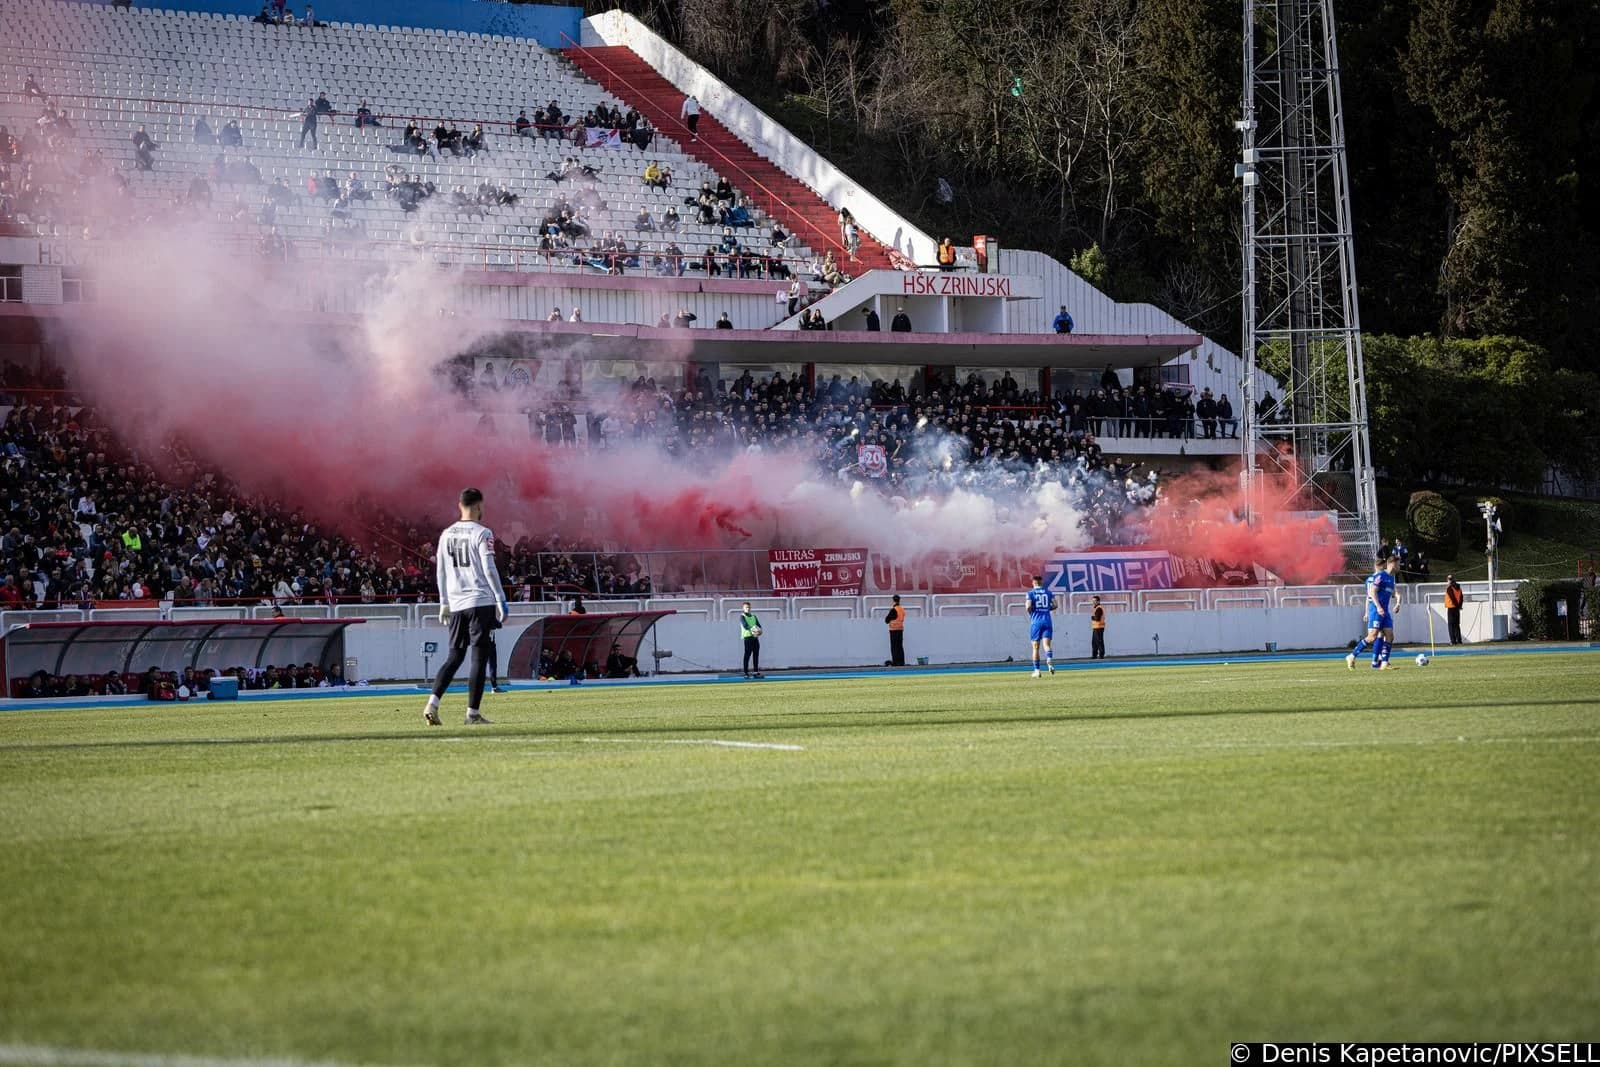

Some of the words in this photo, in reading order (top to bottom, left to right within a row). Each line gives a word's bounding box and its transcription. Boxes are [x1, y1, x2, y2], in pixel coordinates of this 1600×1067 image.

[903, 272, 936, 294] HŠK
[941, 276, 1011, 296] ZRINJSKI
[865, 451, 881, 464] 20
[447, 537, 471, 568] 40
[774, 549, 815, 561] ULTRAS
[1035, 593, 1049, 608] 20
